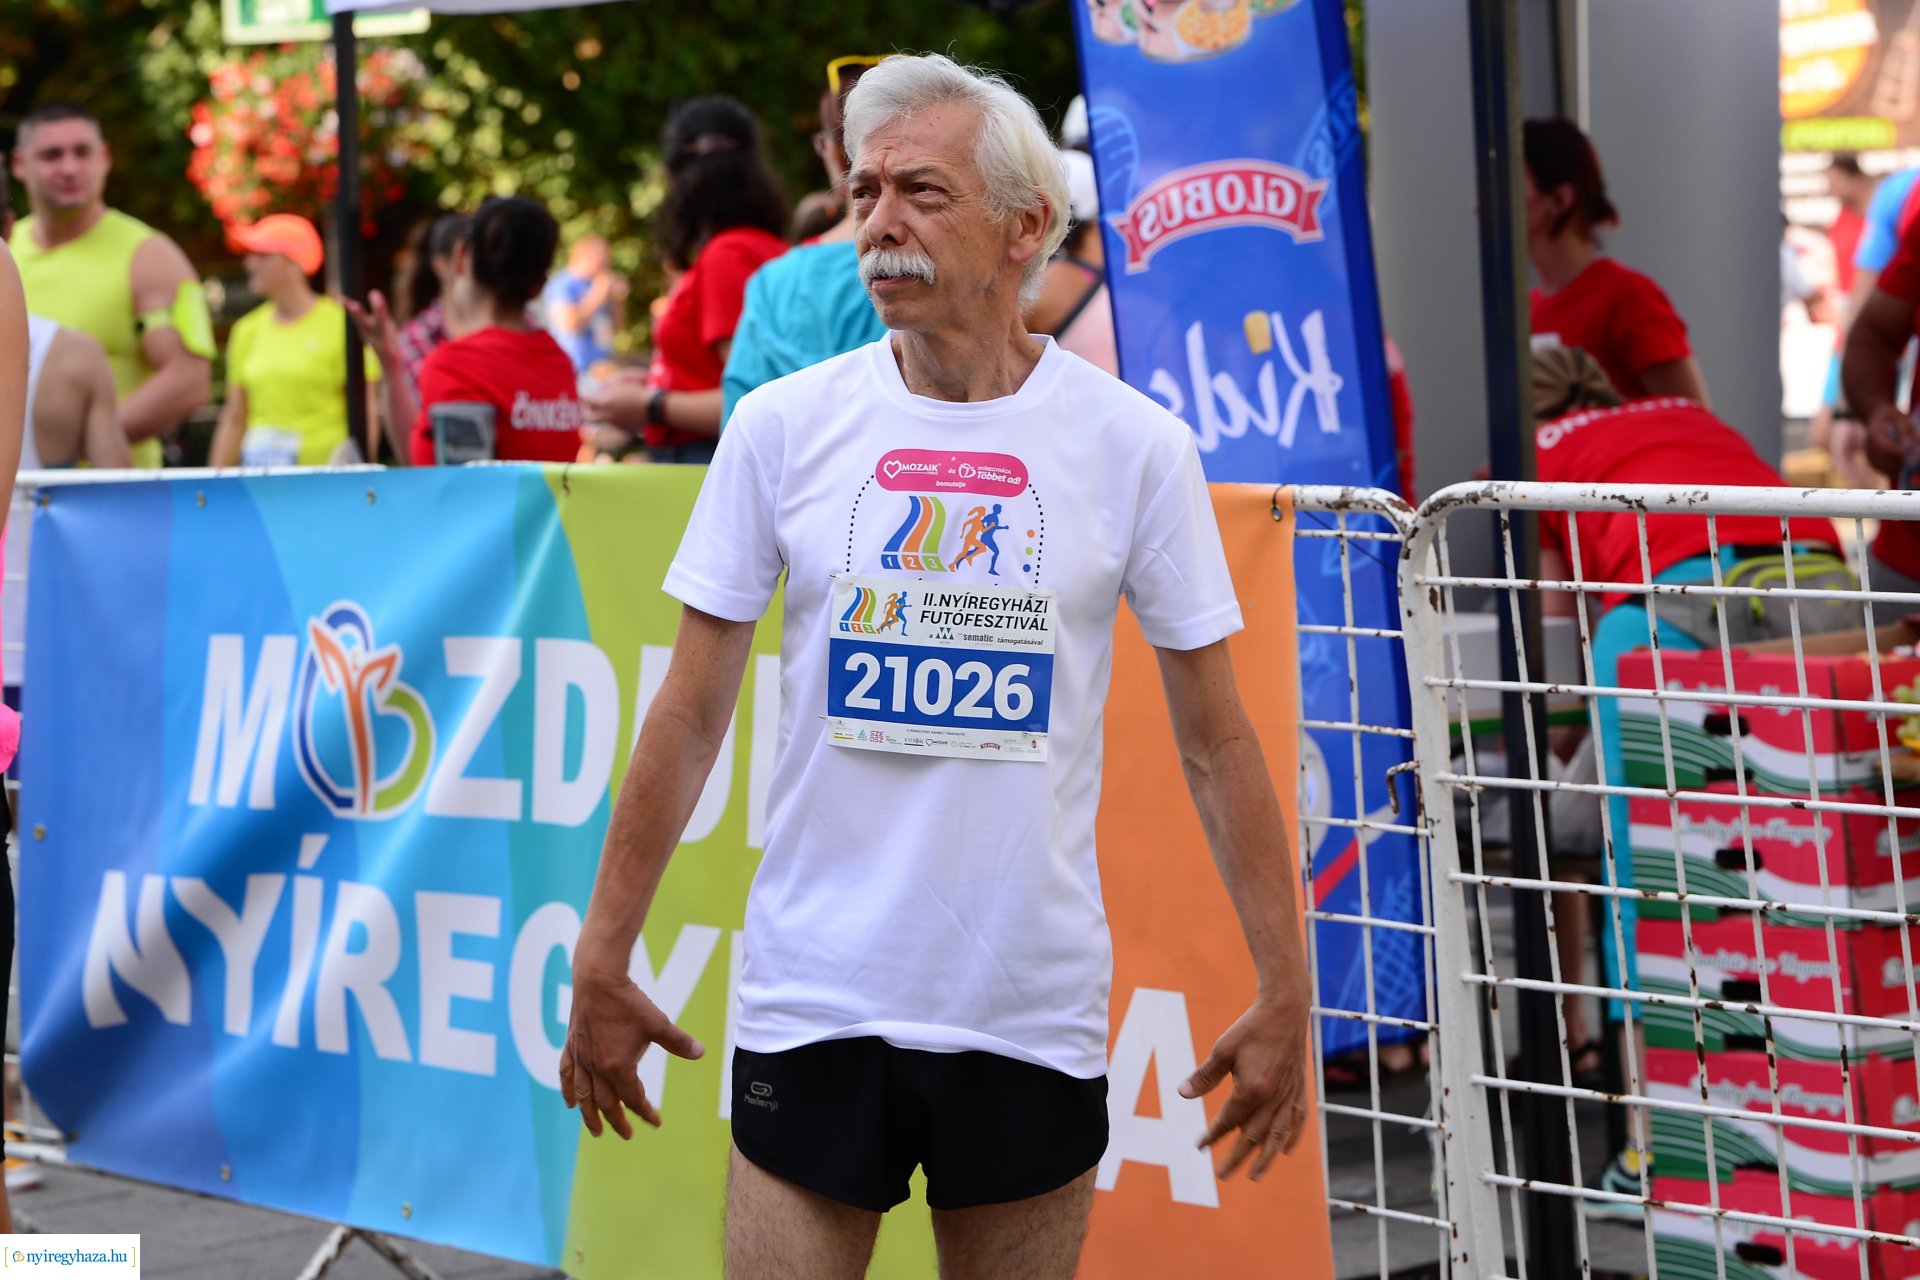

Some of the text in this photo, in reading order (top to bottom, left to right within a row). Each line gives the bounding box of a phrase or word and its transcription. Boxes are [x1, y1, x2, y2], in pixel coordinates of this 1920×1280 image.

[901, 463, 938, 472] MOZAIK
[1007, 477, 1022, 486] ad!
[886, 558, 938, 569] 1 2 3
[920, 609, 1049, 631] FUTÓFESZTIVÁL
[963, 633, 994, 643] sematic
[844, 652, 1034, 722] 21026
[870, 730, 885, 738] SZE
